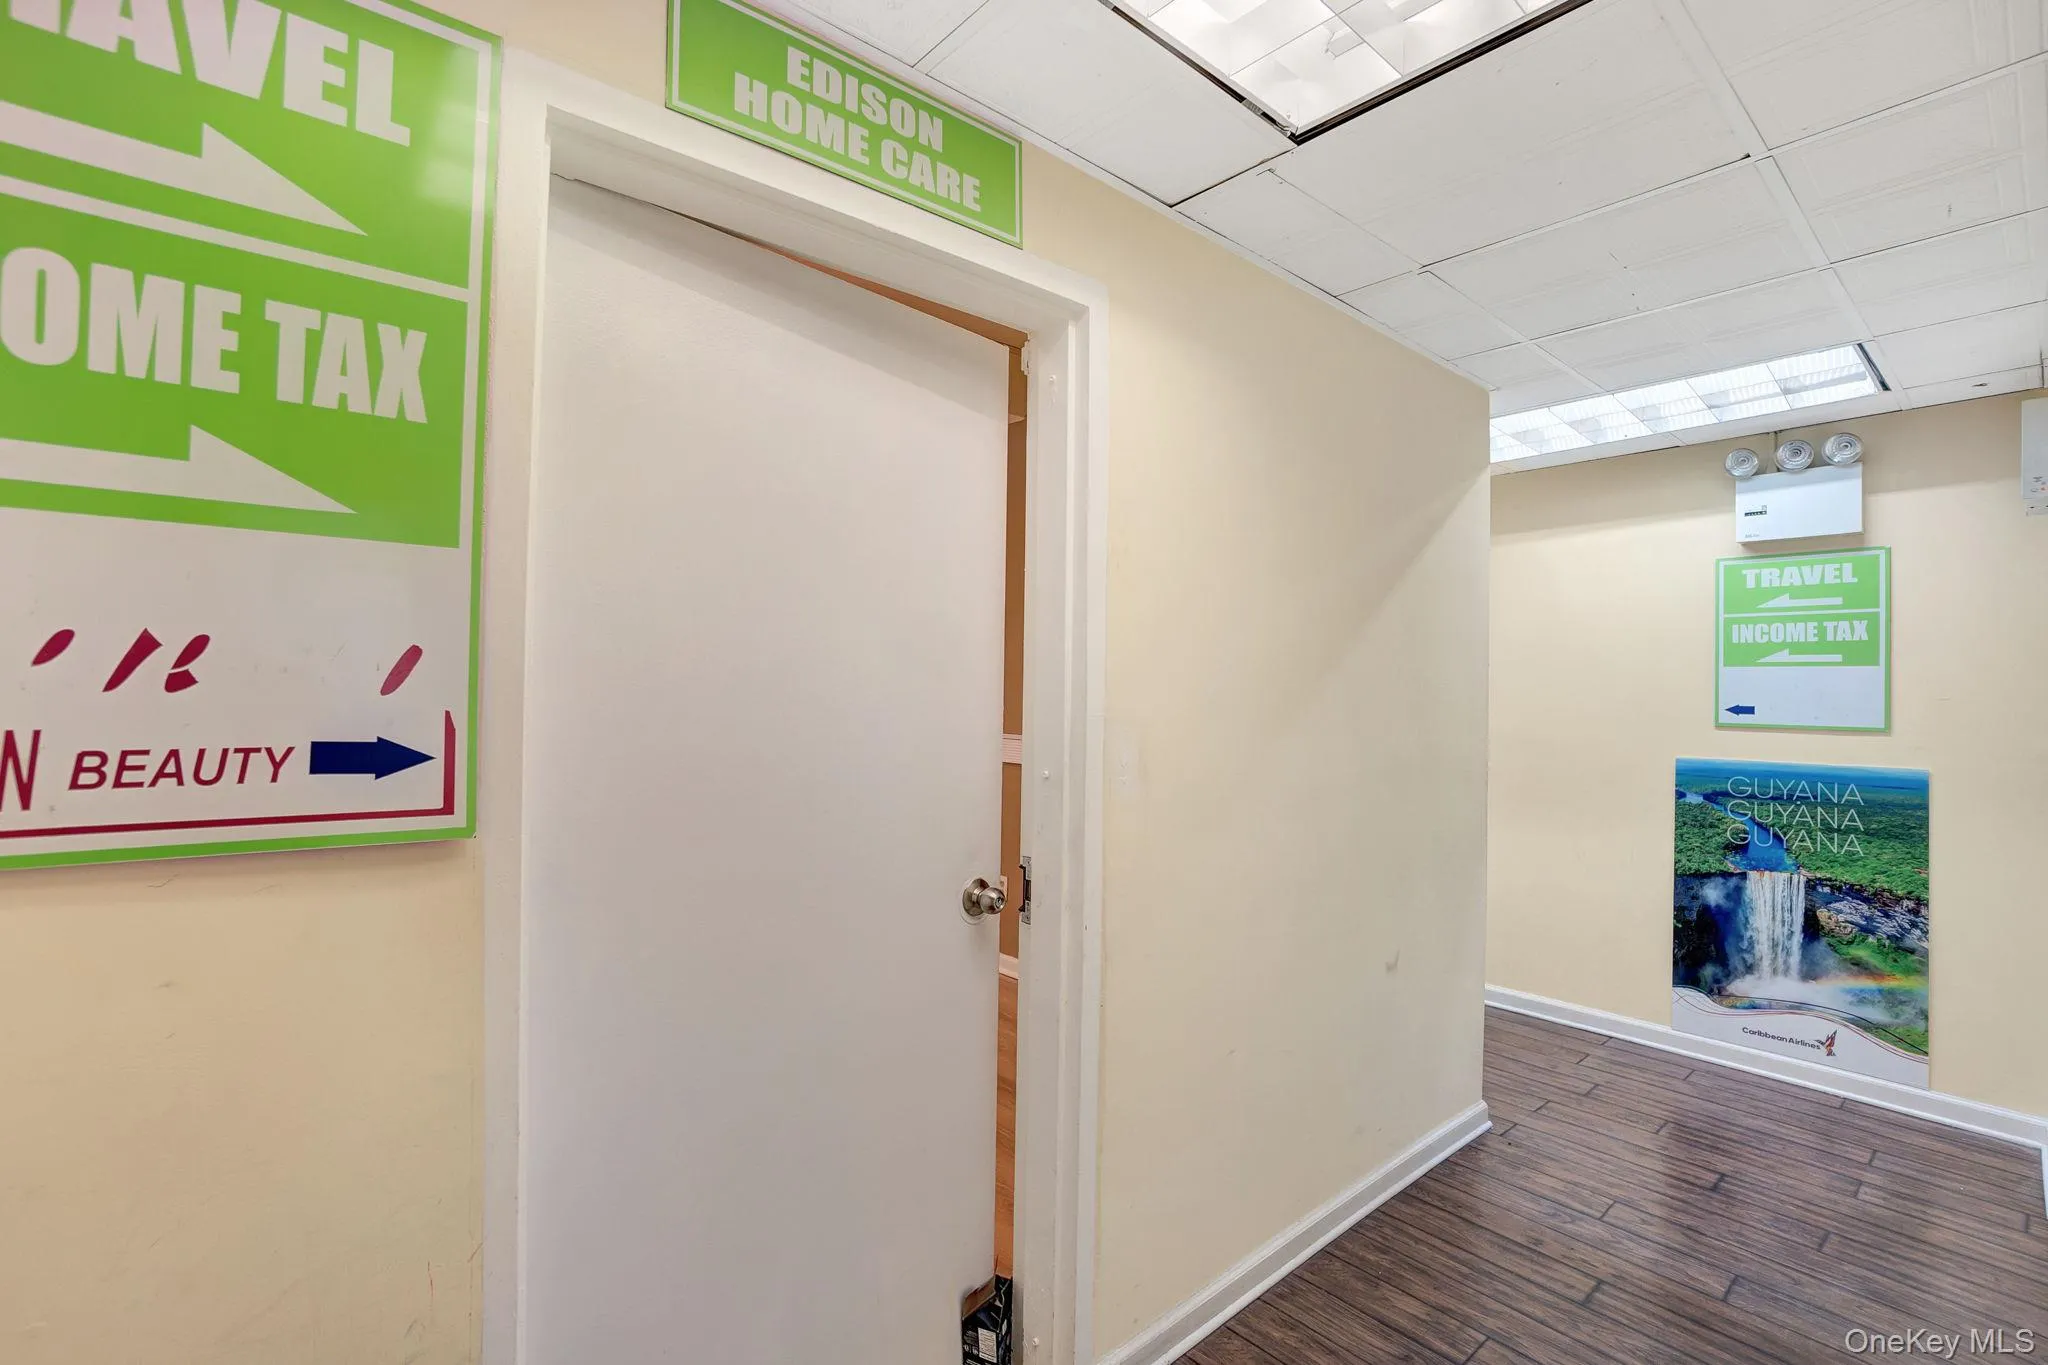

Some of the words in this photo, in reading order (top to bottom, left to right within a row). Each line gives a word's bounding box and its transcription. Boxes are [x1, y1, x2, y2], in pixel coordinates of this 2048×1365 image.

[786, 45, 943, 153] EDISON
[734, 71, 870, 166] HOME
[880, 138, 982, 212] CARE
[265, 299, 428, 424] TAX
[1742, 562, 1858, 589] TRAVEL
[1731, 621, 1818, 644] INCOME
[1823, 619, 1869, 642] TAX
[68, 746, 296, 791] BEAUTY
[1727, 776, 1865, 806] GUYANA
[1727, 800, 1865, 831] GUYANA
[1727, 823, 1865, 857] GUYANA
[1742, 1026, 1788, 1043] Caribbean
[1788, 1037, 1821, 1050] Airlines
